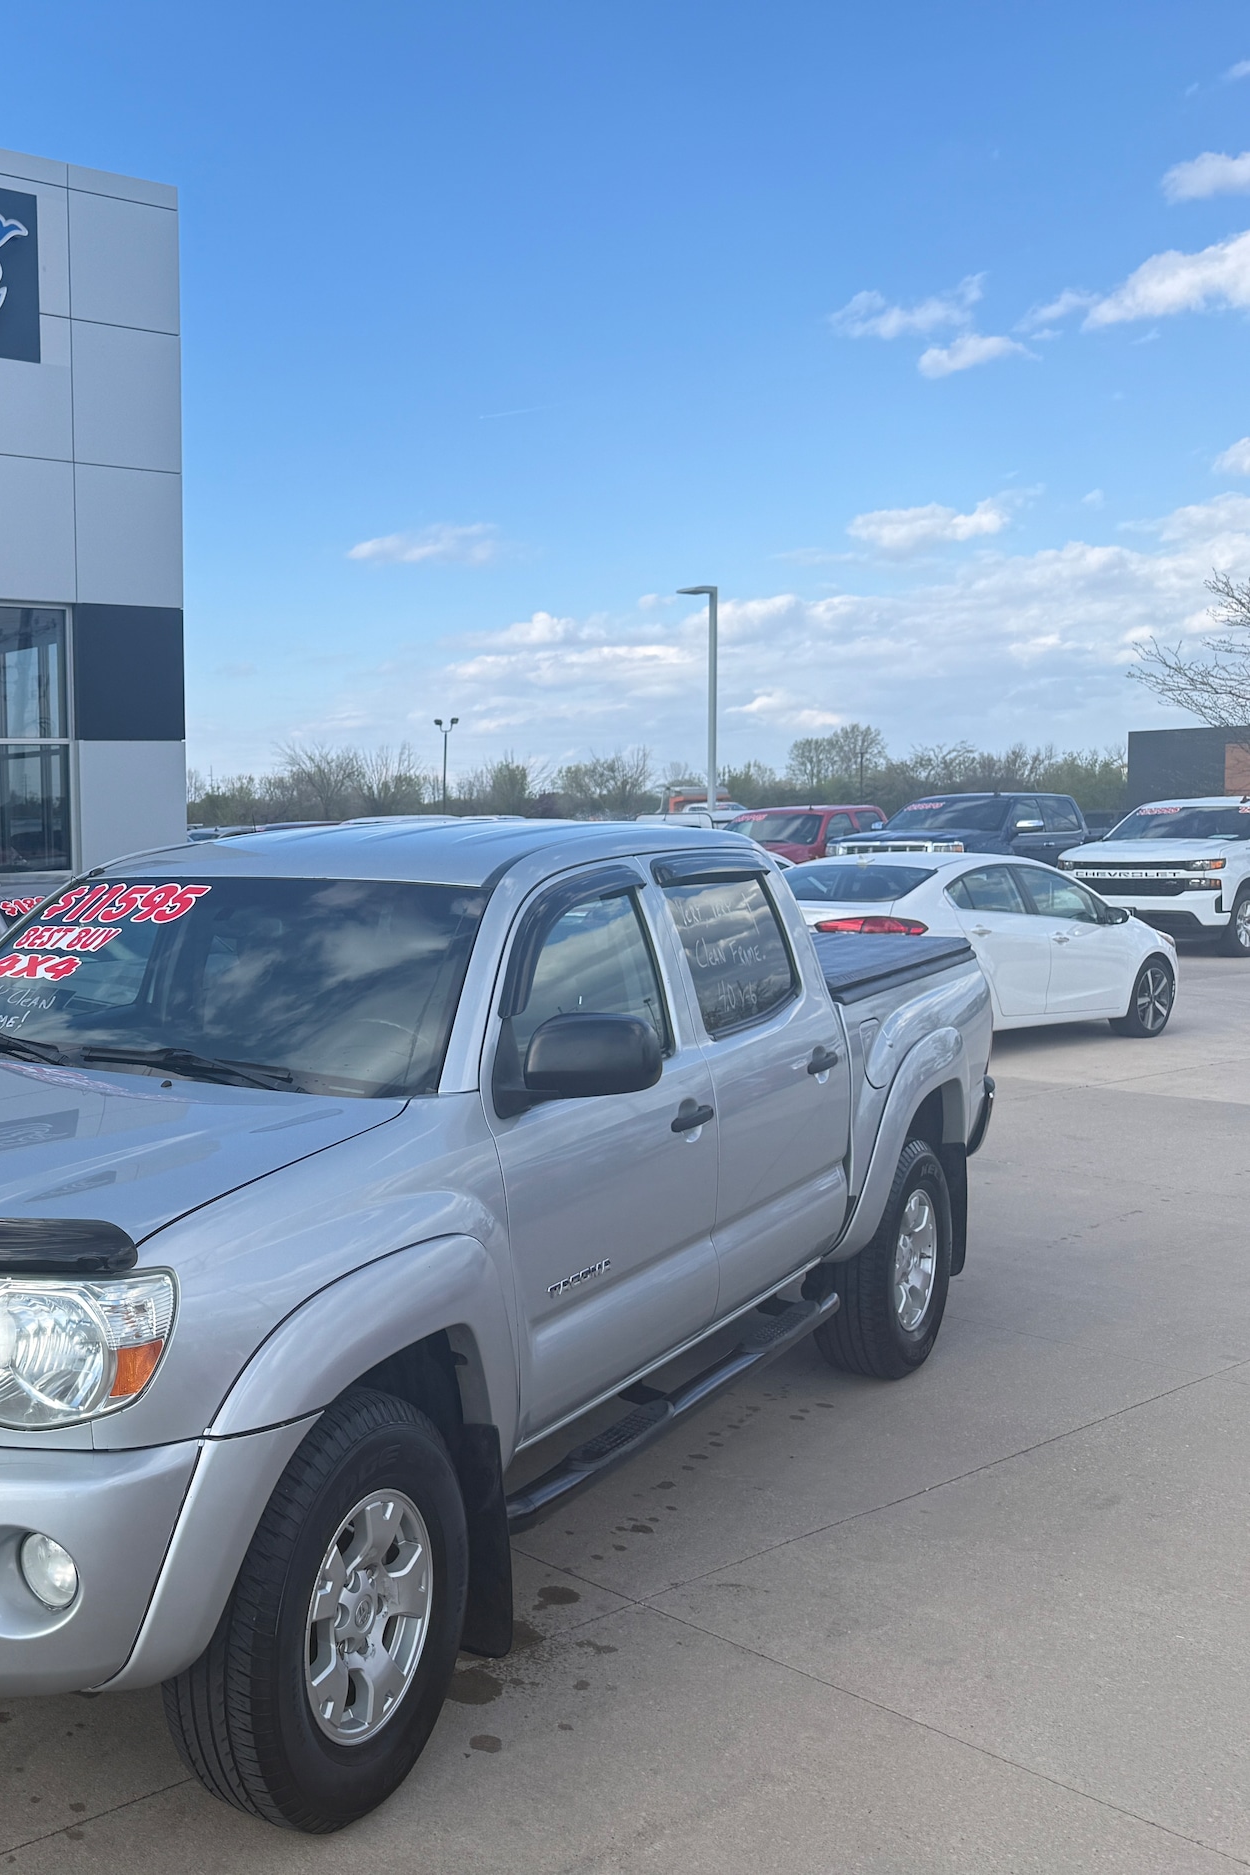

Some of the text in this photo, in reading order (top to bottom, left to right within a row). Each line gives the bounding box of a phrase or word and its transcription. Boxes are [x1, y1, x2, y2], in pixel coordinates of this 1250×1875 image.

[41, 883, 212, 924] $11595
[13, 926, 122, 952] BEST BUY
[547, 1257, 611, 1298] TACOMA
